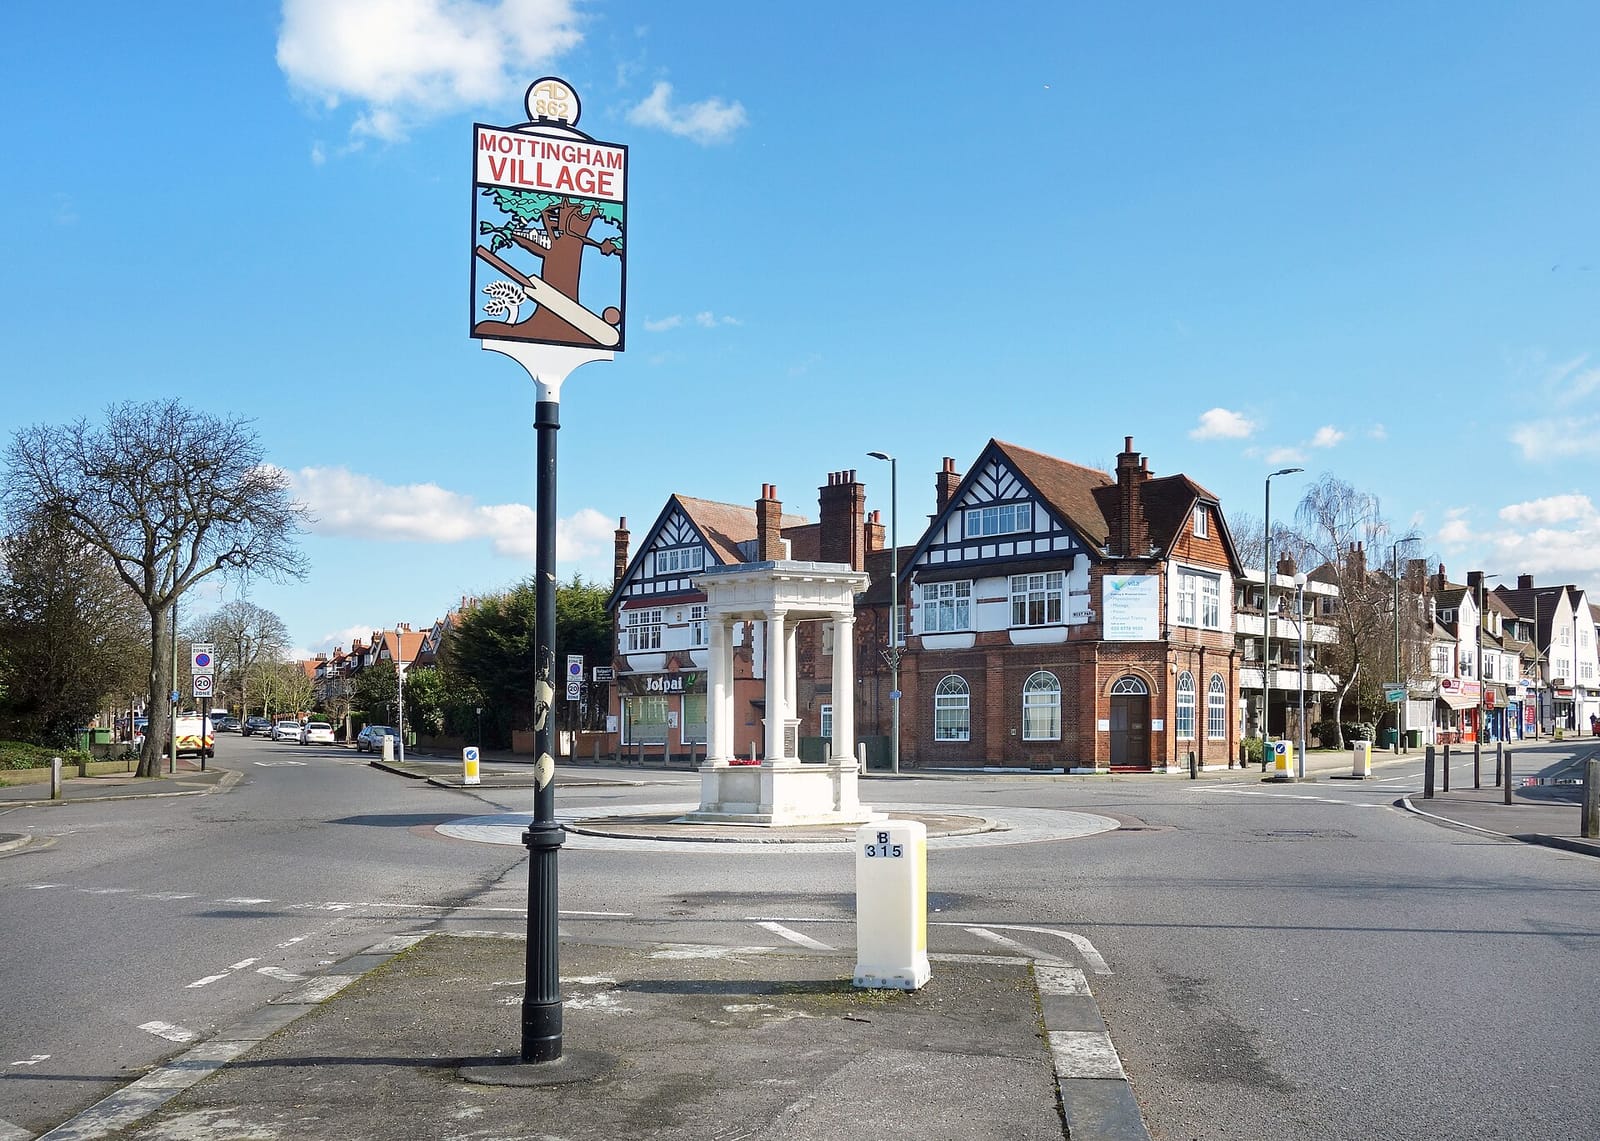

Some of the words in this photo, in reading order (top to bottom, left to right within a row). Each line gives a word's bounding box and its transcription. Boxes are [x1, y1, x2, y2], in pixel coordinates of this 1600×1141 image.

[533, 83, 569, 100] AD
[535, 99, 569, 118] 862
[480, 133, 622, 170] MOTTINGHAM
[488, 155, 614, 197] VILLAGE
[646, 677, 683, 693] Jolpai
[878, 832, 889, 844] B
[867, 845, 901, 858] 315
